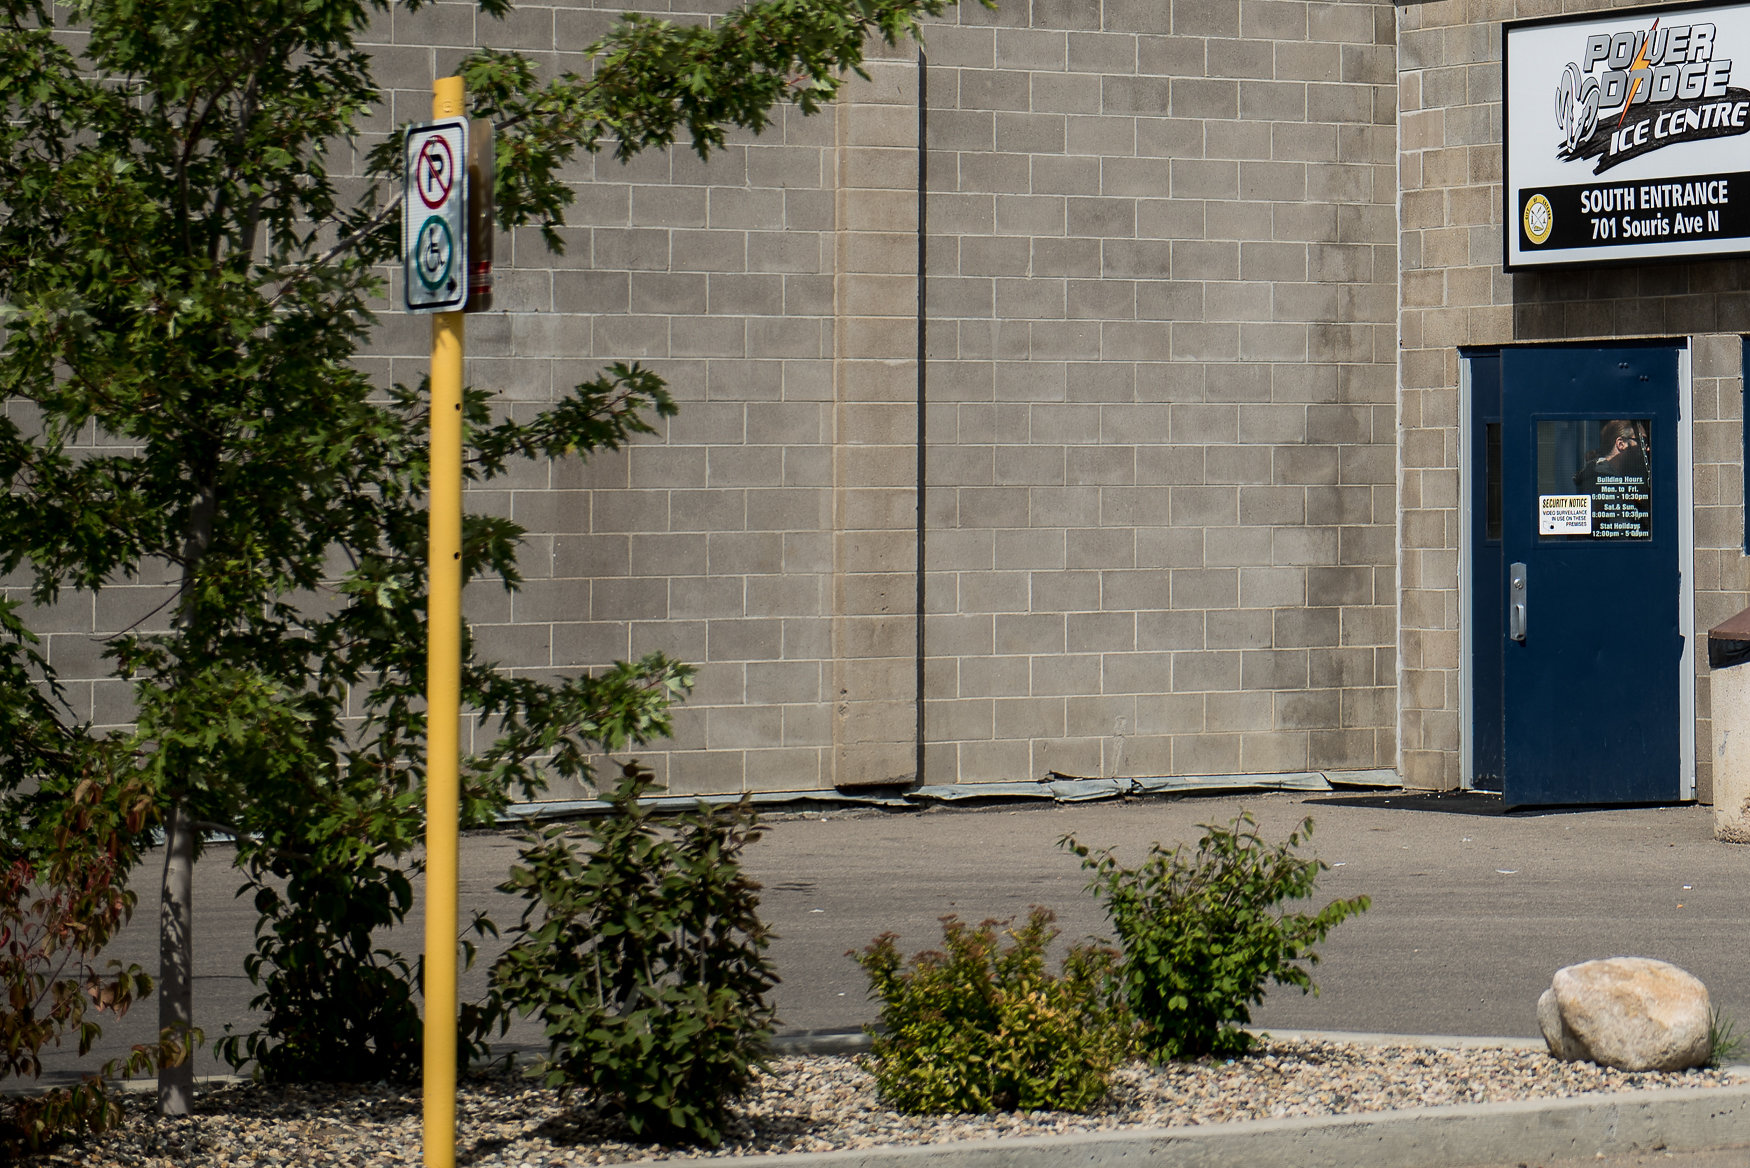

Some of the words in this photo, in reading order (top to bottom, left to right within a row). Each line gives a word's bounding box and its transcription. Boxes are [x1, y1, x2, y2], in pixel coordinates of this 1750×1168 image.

[1583, 23, 1716, 73] POWER
[1598, 59, 1732, 108] DODGE
[1609, 119, 1650, 156] ICE
[1654, 102, 1749, 139] CENTRE
[1580, 187, 1635, 214] SOUTH
[1640, 180, 1729, 209] ENTRANCE
[1590, 217, 1617, 240] 701
[1622, 212, 1670, 238] Souris
[1673, 213, 1703, 234] Ave
[1707, 210, 1719, 232] N
[1542, 498, 1567, 508] SECURITY
[1569, 498, 1587, 508] NOTICE
[1613, 522, 1640, 530] Holidays
